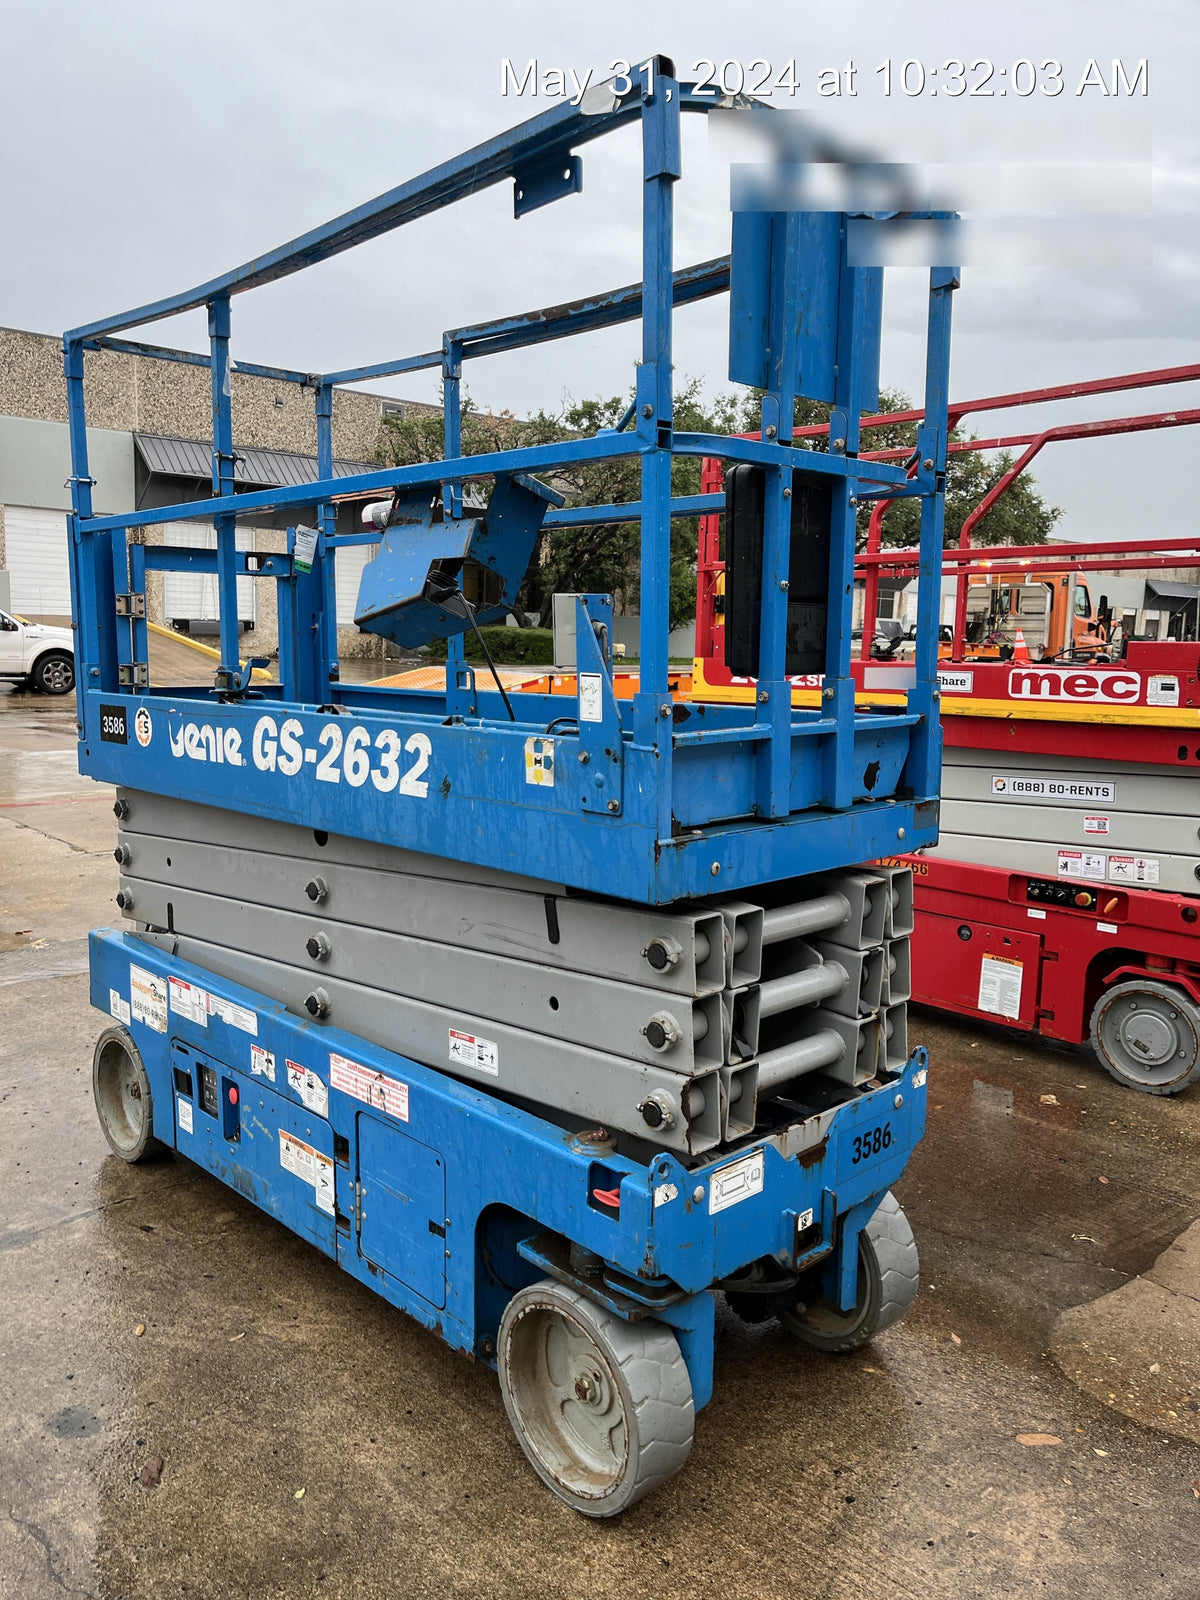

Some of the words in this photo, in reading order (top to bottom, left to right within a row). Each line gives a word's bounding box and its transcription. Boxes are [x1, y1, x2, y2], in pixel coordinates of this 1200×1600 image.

[1010, 672, 1140, 700] mec
[102, 715, 125, 736] 3586
[252, 715, 433, 799] GS-2632
[1012, 781, 1045, 793] (888)
[1049, 784, 1110, 797] 80-RENTS
[851, 1121, 892, 1165] 3586
